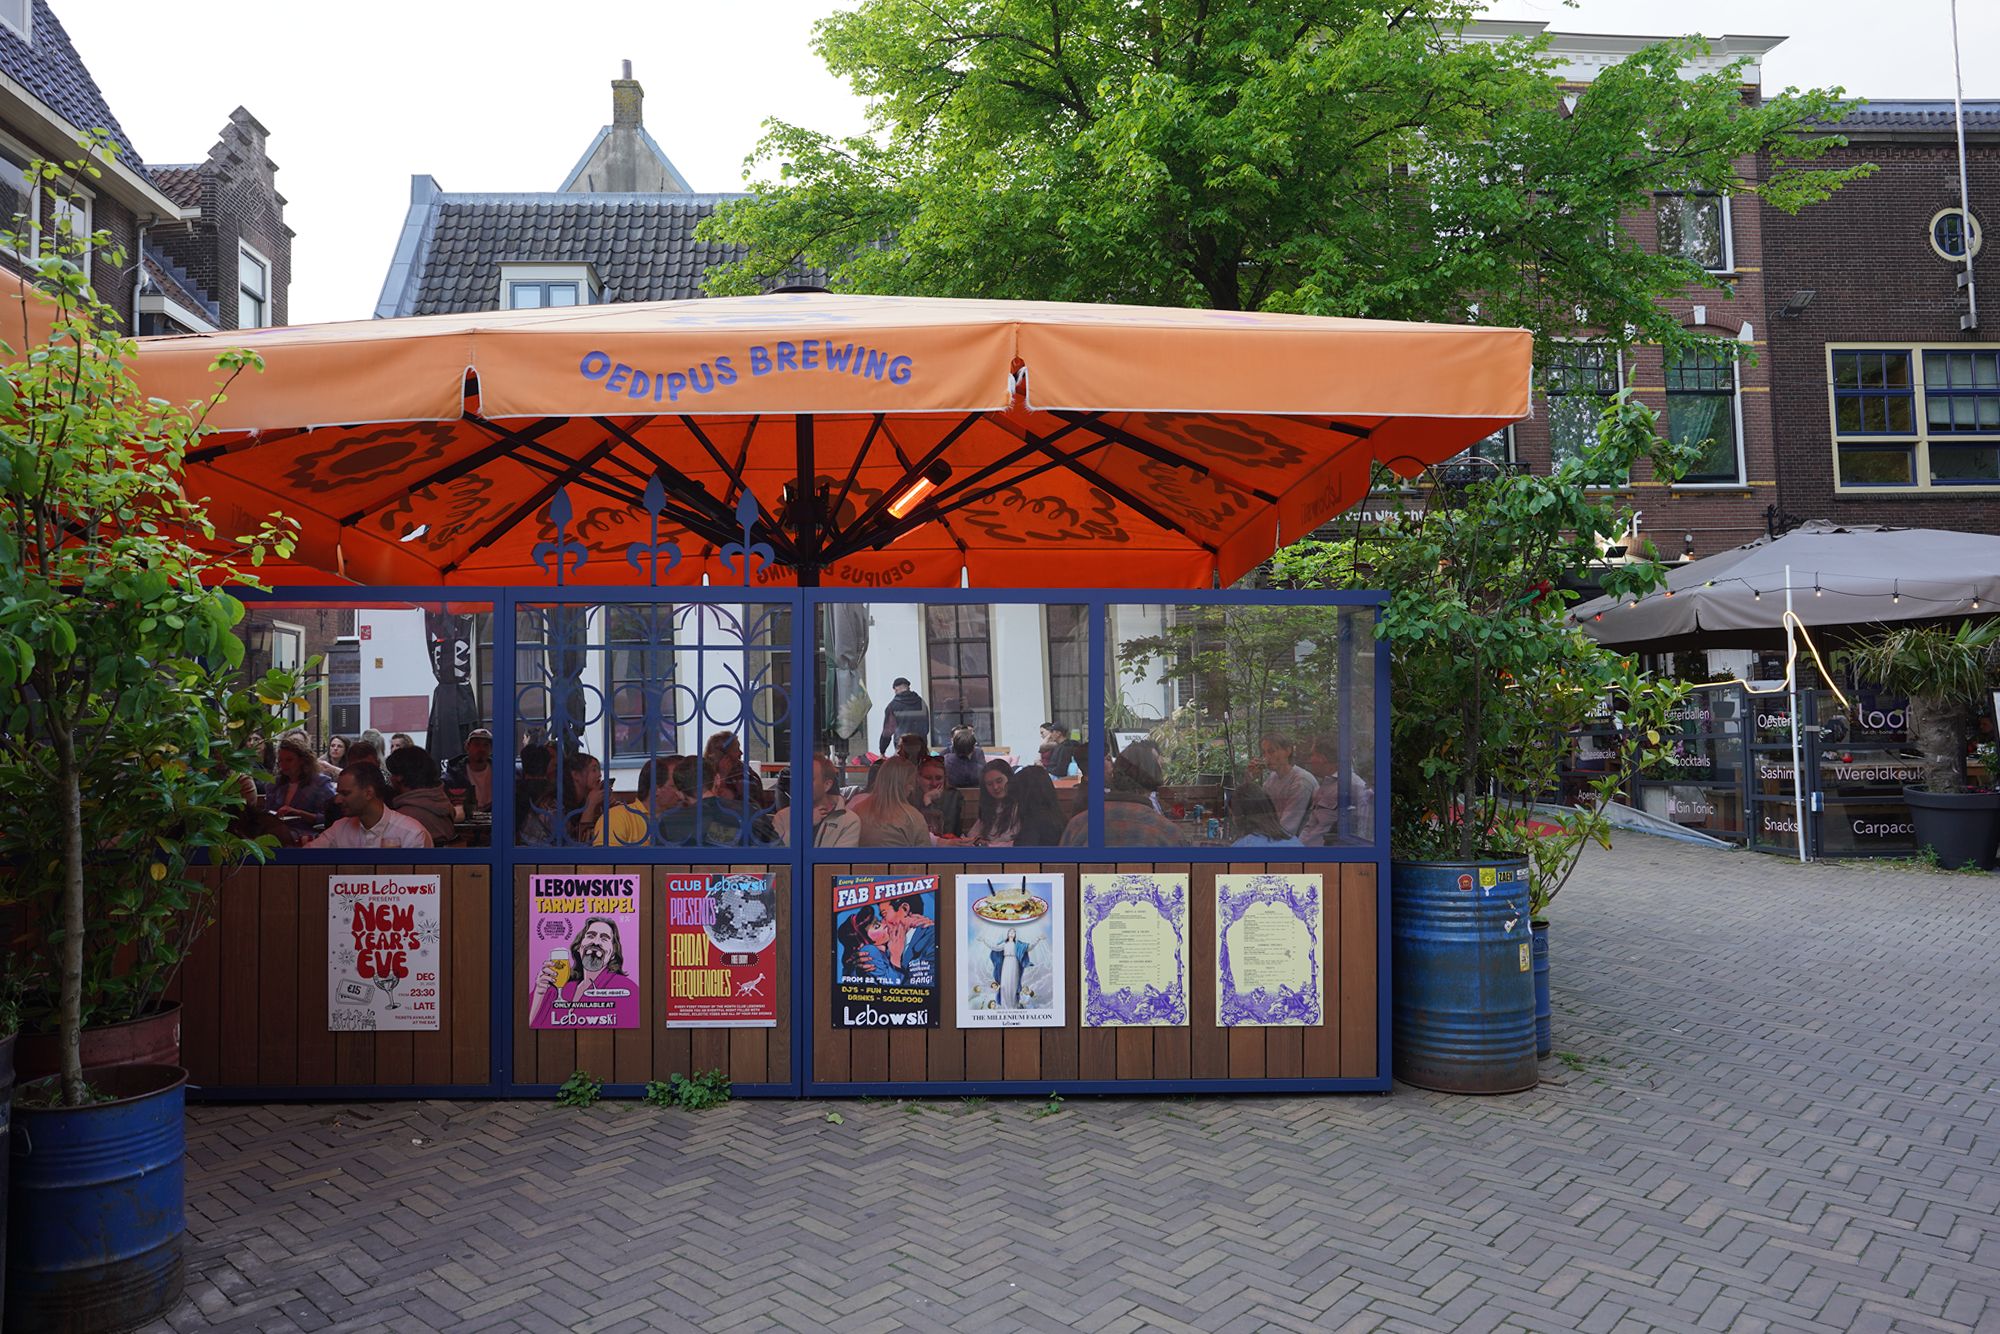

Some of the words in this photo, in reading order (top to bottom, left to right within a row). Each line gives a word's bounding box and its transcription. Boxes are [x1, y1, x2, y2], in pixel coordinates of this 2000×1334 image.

[580, 350, 737, 402] OEDIPUS
[750, 339, 912, 385] BREWING
[1757, 714, 1792, 728] Oester
[1859, 703, 1912, 728] loof
[1676, 754, 1711, 768] Cocktails
[1760, 766, 1796, 780] Sashim
[1835, 766, 1925, 781] Wereldkeuk
[1676, 801, 1690, 813] Gin
[1692, 802, 1714, 815] Tonic
[1764, 817, 1799, 832] Snacks
[1853, 820, 1915, 837] Carpacc
[334, 883, 370, 895] CLUB
[372, 879, 435, 895] Lebowski
[535, 879, 633, 896] LEBOWSKI'S
[670, 880, 702, 891] CLUB
[705, 875, 767, 891] Lebowski
[838, 887, 868, 908] FAB
[874, 877, 935, 900] FRIDAY
[535, 898, 585, 913] TARWE
[586, 898, 636, 913] TRIPEL
[670, 897, 717, 926] PRESENTS
[351, 902, 414, 932] NEW
[351, 930, 421, 951] YEAR'S
[670, 933, 710, 967] FRIDAY
[357, 949, 409, 979] EVE
[416, 973, 435, 981] DEC
[670, 969, 732, 999] FREQUENCIES
[910, 975, 933, 985] BANG!
[347, 984, 362, 995] €15
[410, 988, 435, 997] 23:30
[889, 988, 930, 996] COCKTAILS
[413, 1002, 435, 1010] LATE
[551, 1008, 616, 1025] Lebowski
[843, 1004, 928, 1025] Lebowski
